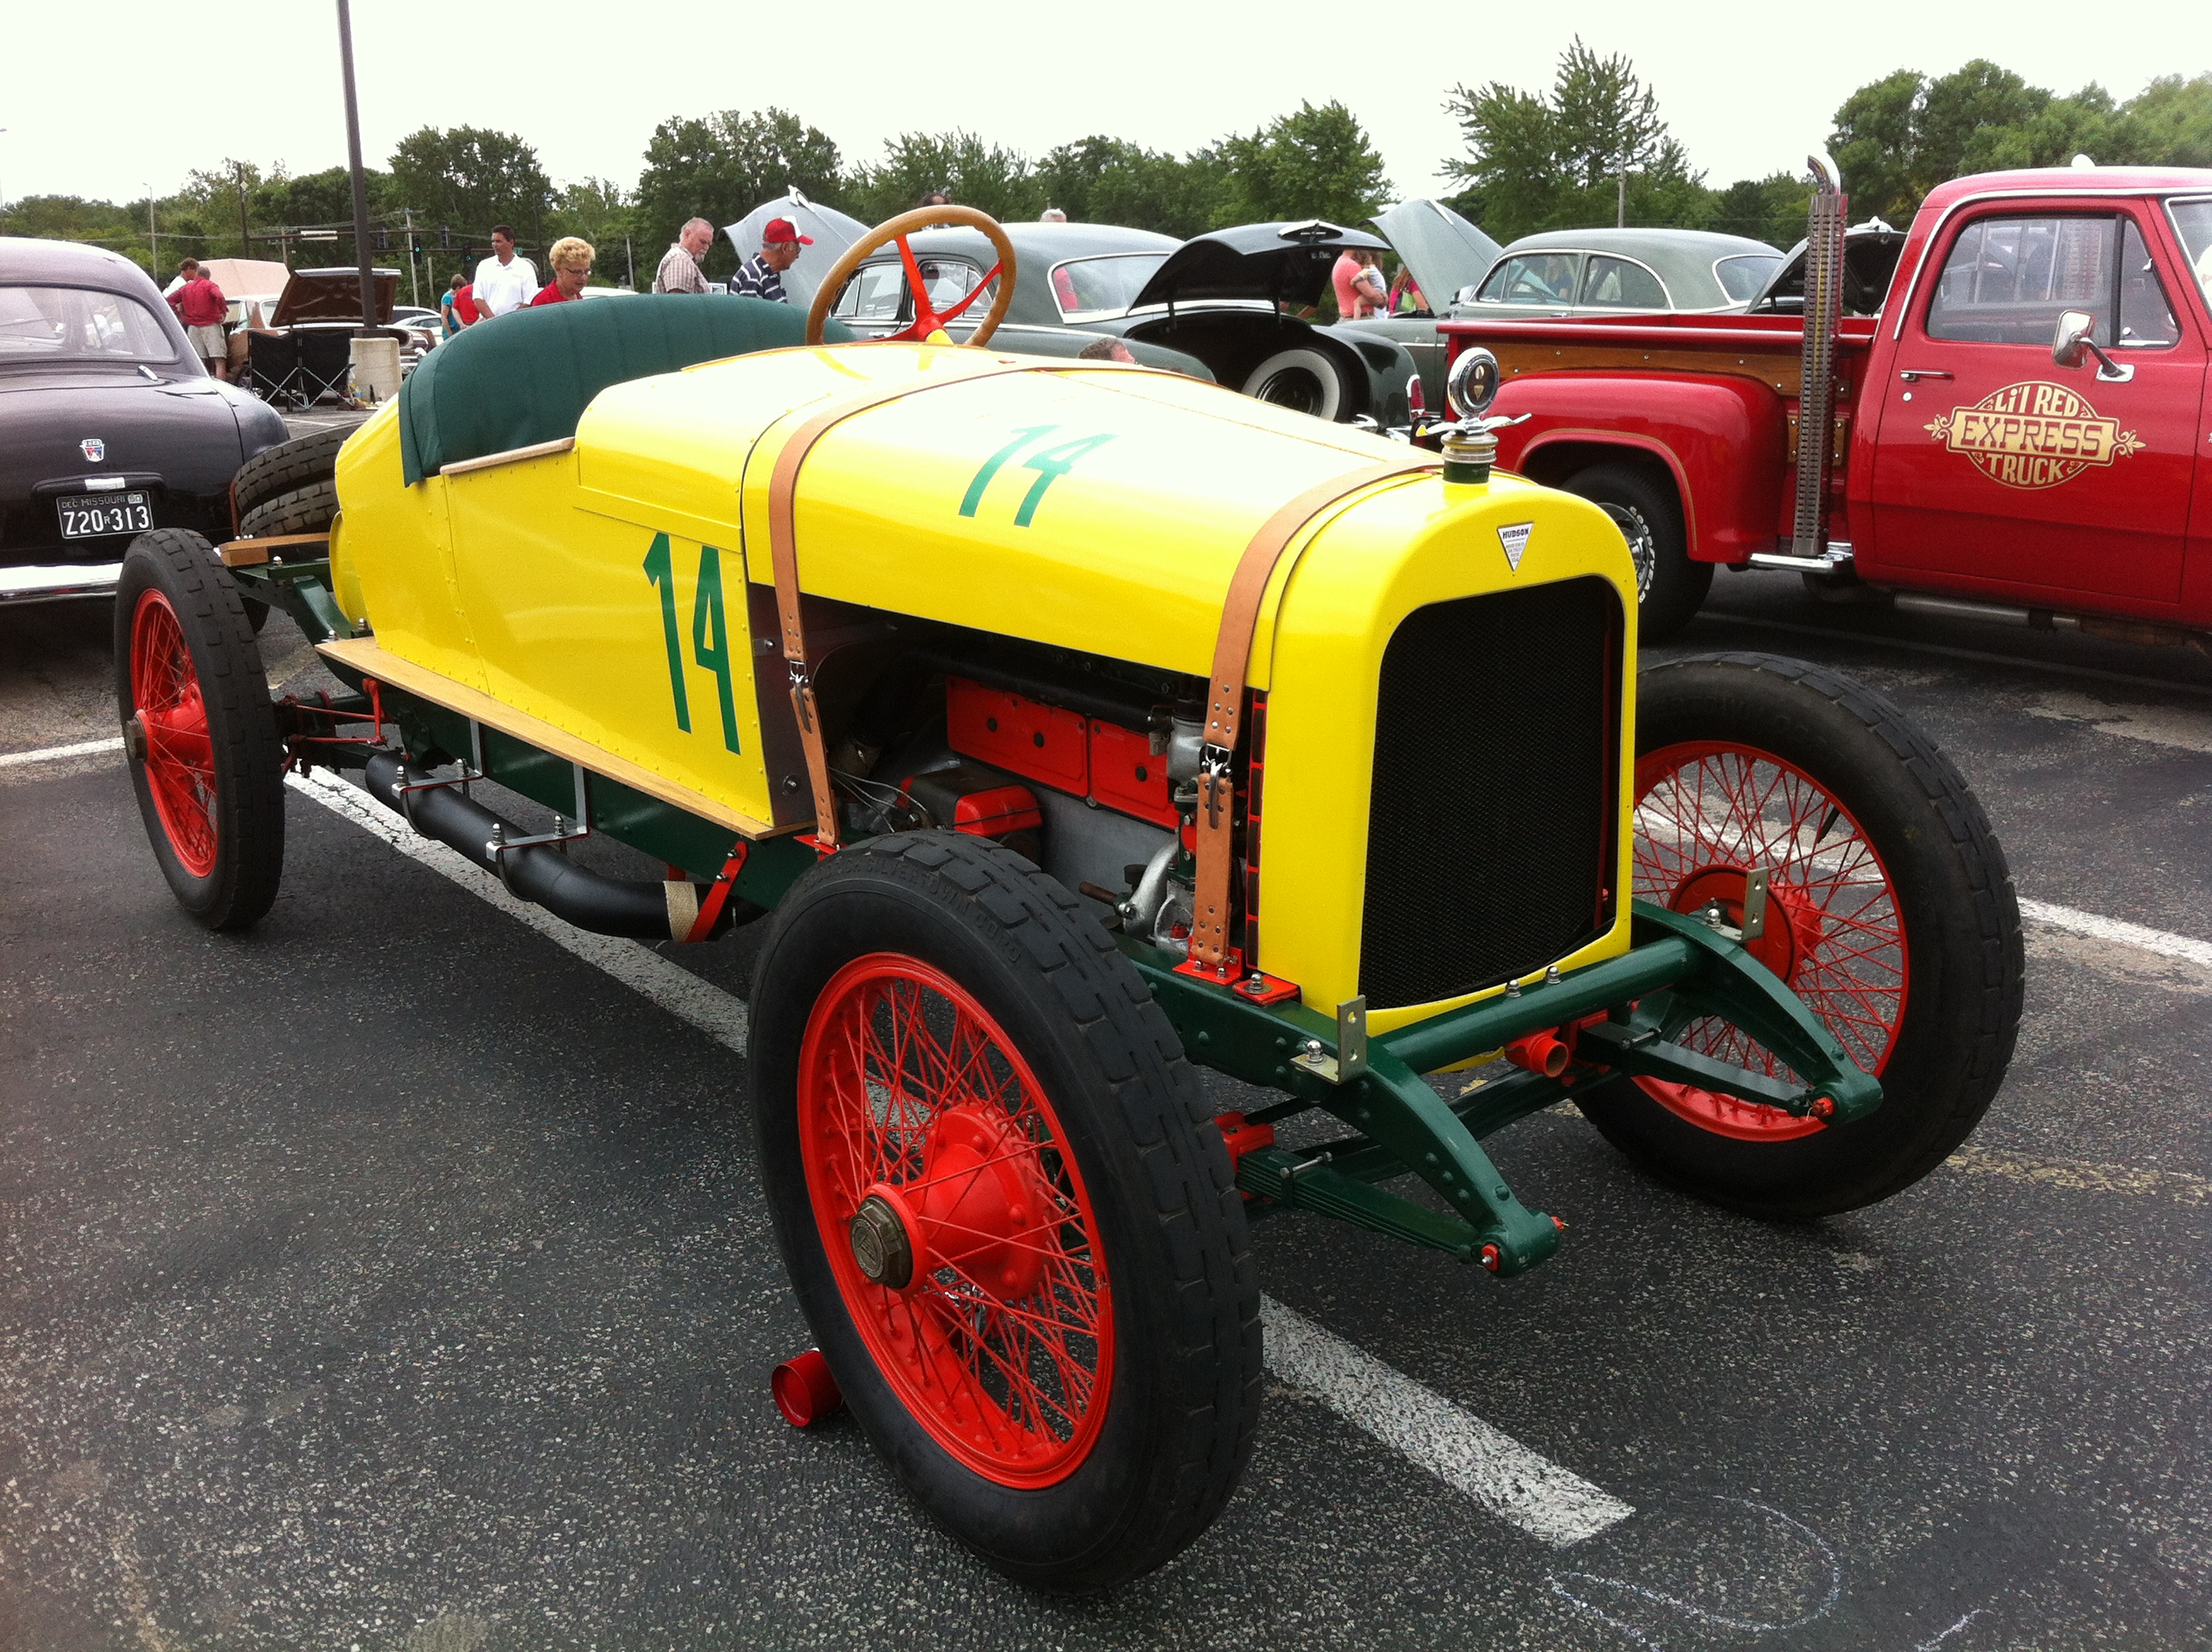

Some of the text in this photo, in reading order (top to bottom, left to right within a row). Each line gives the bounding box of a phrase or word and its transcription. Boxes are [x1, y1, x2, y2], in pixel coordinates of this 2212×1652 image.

[2033, 385, 2080, 418] RED
[1960, 414, 2103, 457] EXPRESS
[958, 424, 1119, 527] 14
[1986, 452, 2068, 486] TRUCK
[81, 495, 125, 507] MISSOURI
[1503, 527, 1528, 538] HUDSON
[1629, 506, 1656, 603] GOODYEAR
[642, 531, 741, 756] 14
